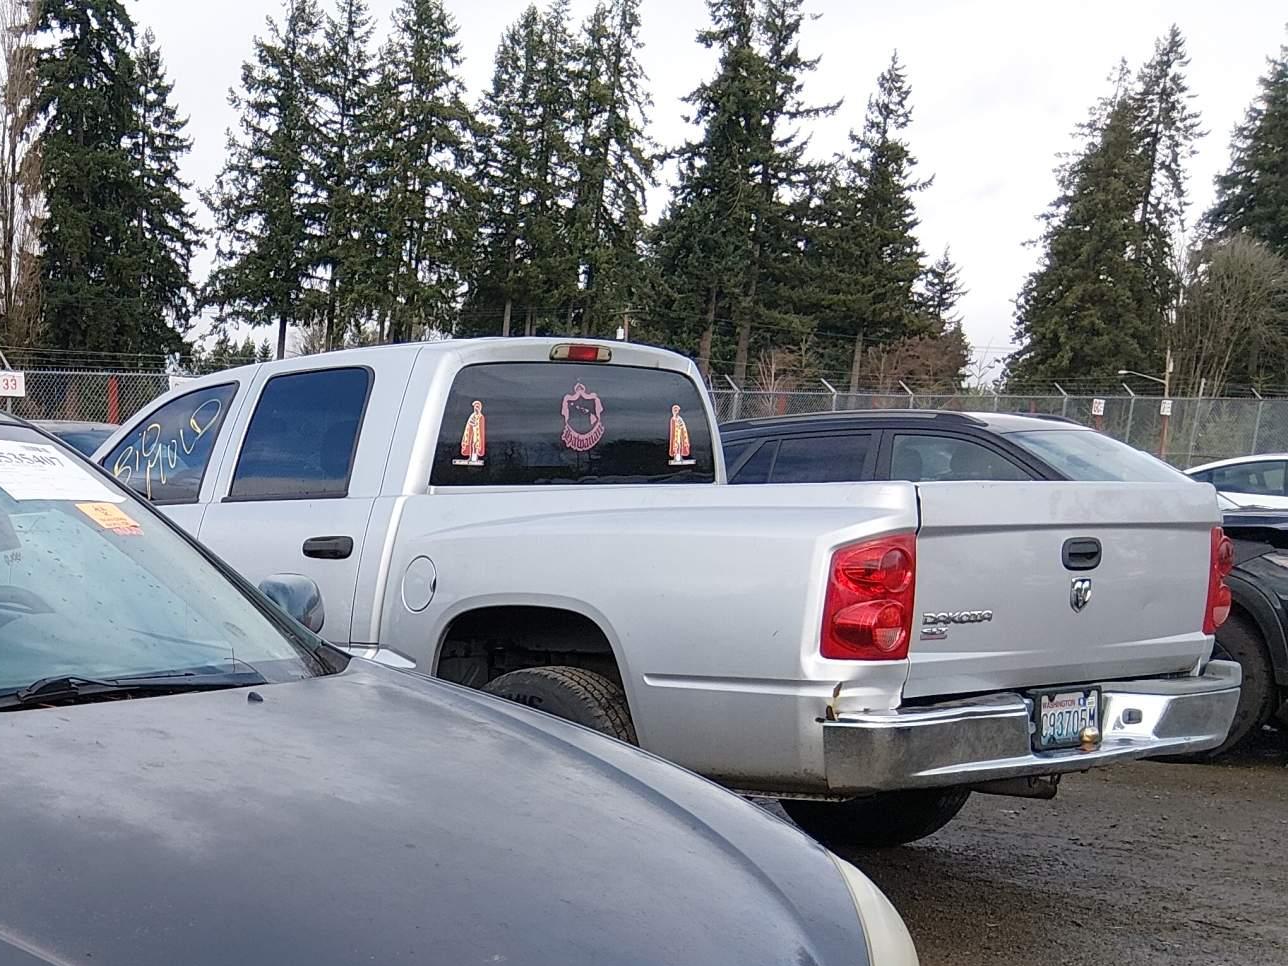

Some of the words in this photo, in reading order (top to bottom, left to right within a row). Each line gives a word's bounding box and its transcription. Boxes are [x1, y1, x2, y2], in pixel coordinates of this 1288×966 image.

[2, 377, 17, 391] 33
[922, 609, 993, 626] DAKOTA
[920, 627, 948, 637] SLT
[1042, 697, 1076, 710] WASHINGTON
[1041, 706, 1096, 738] C93705M
